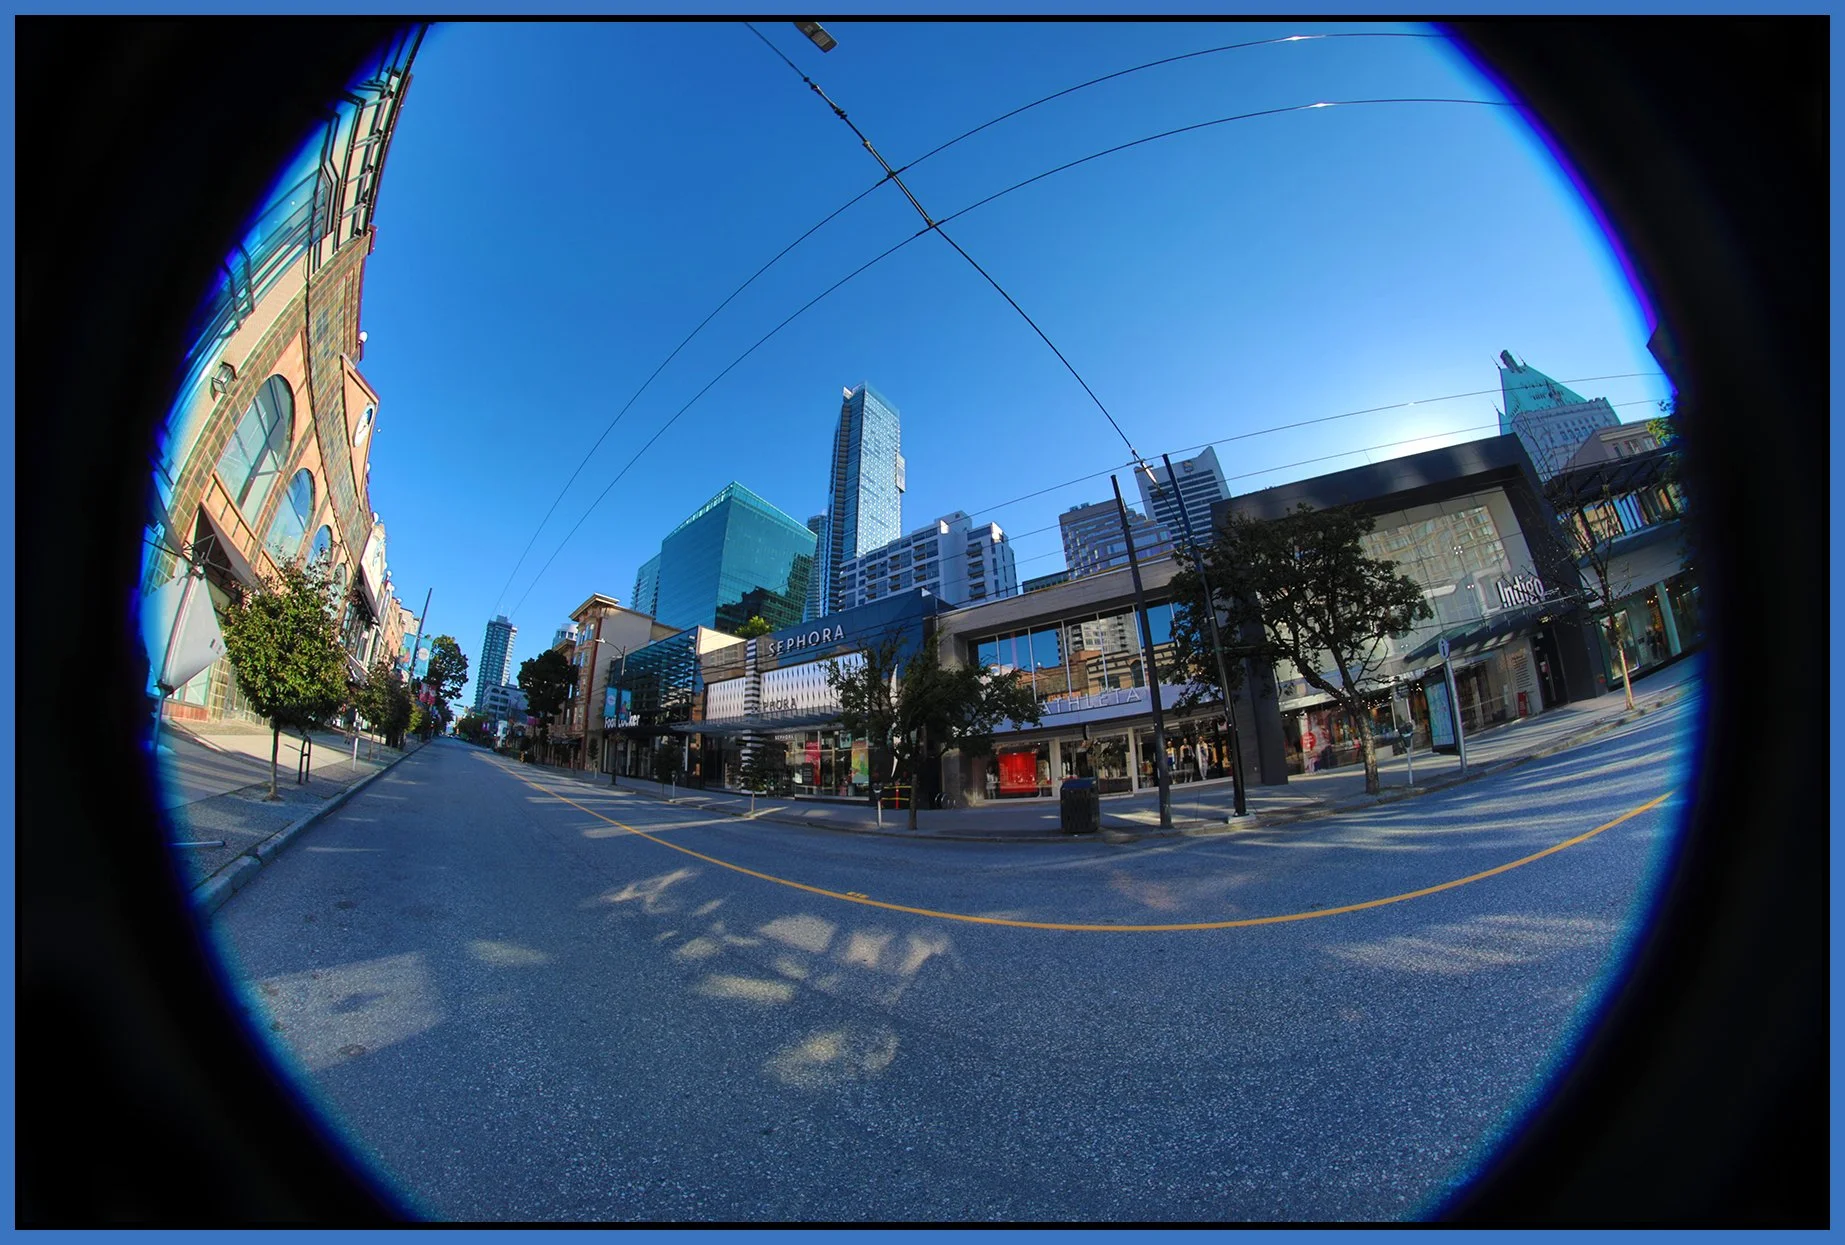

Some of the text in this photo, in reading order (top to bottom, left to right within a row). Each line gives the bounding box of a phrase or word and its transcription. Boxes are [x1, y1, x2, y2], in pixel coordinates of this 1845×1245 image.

[1496, 575, 1545, 608] Indigo
[768, 624, 845, 657] SEPHORA
[1042, 686, 1141, 714] ATHLETA
